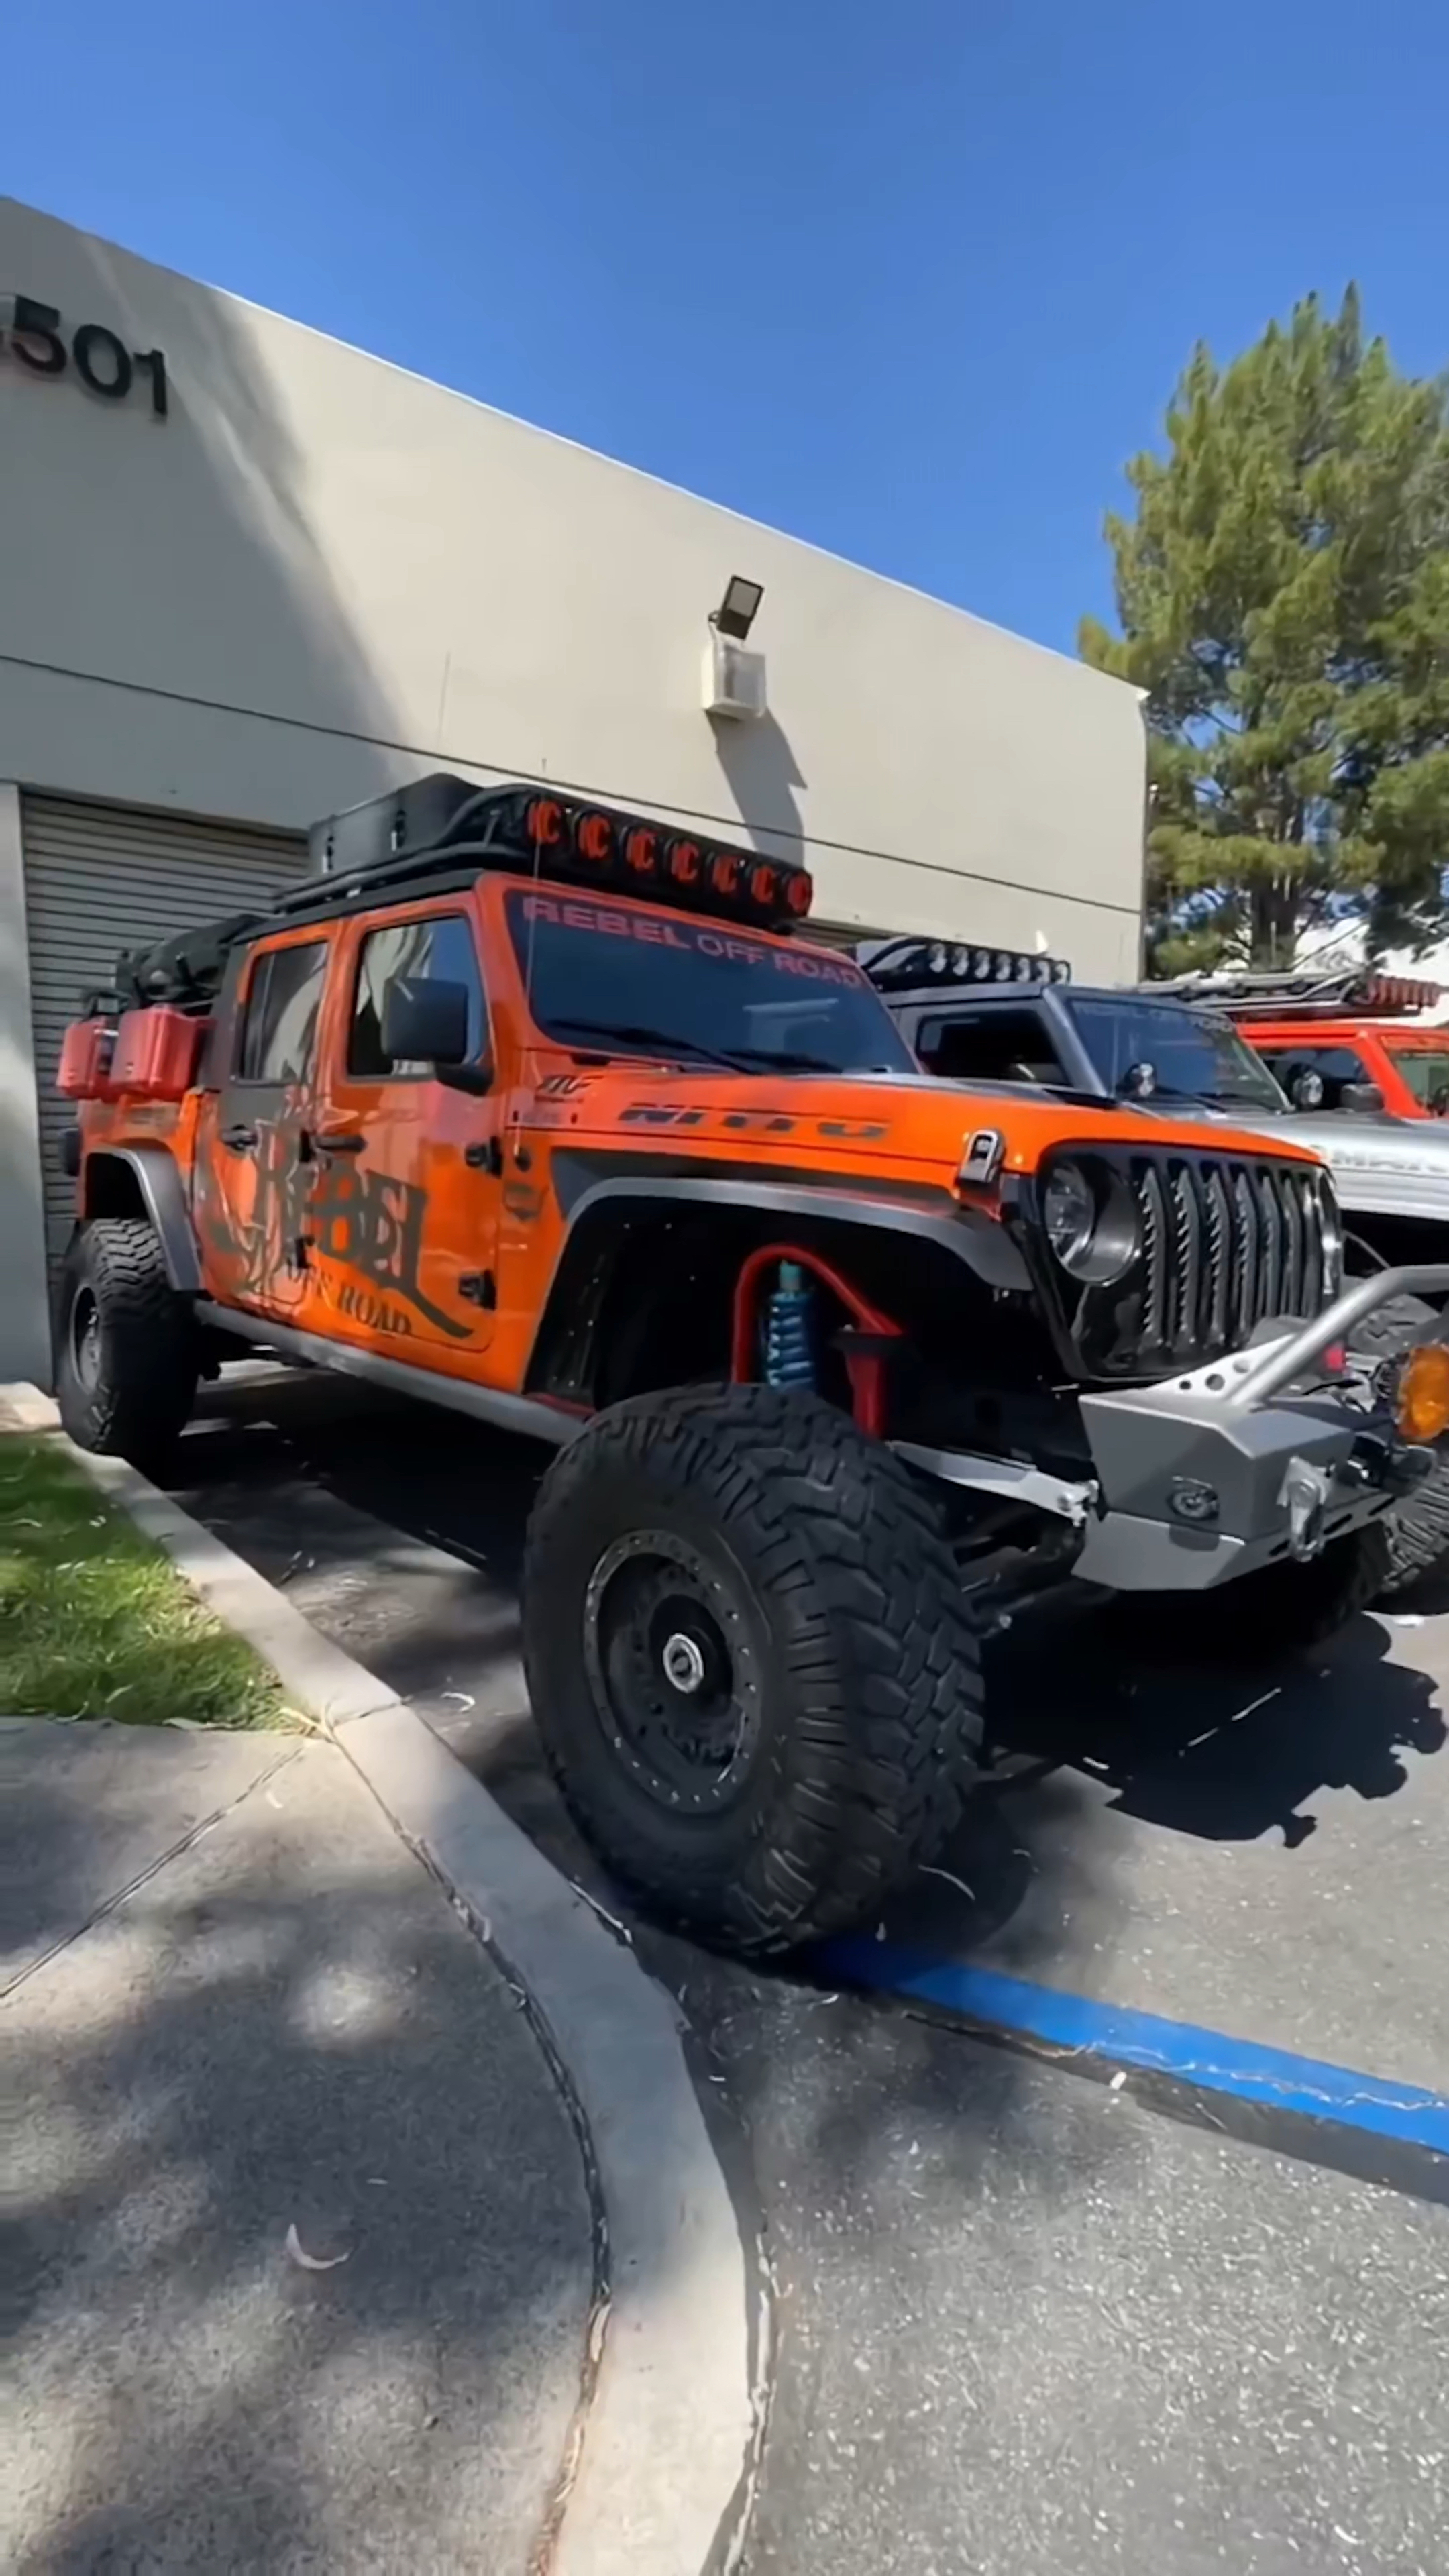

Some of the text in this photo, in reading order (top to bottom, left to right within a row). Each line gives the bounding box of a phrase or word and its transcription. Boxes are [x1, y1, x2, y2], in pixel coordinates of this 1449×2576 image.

[0, 294, 168, 416] 501
[523, 895, 864, 989] REBEL OFF ROAD
